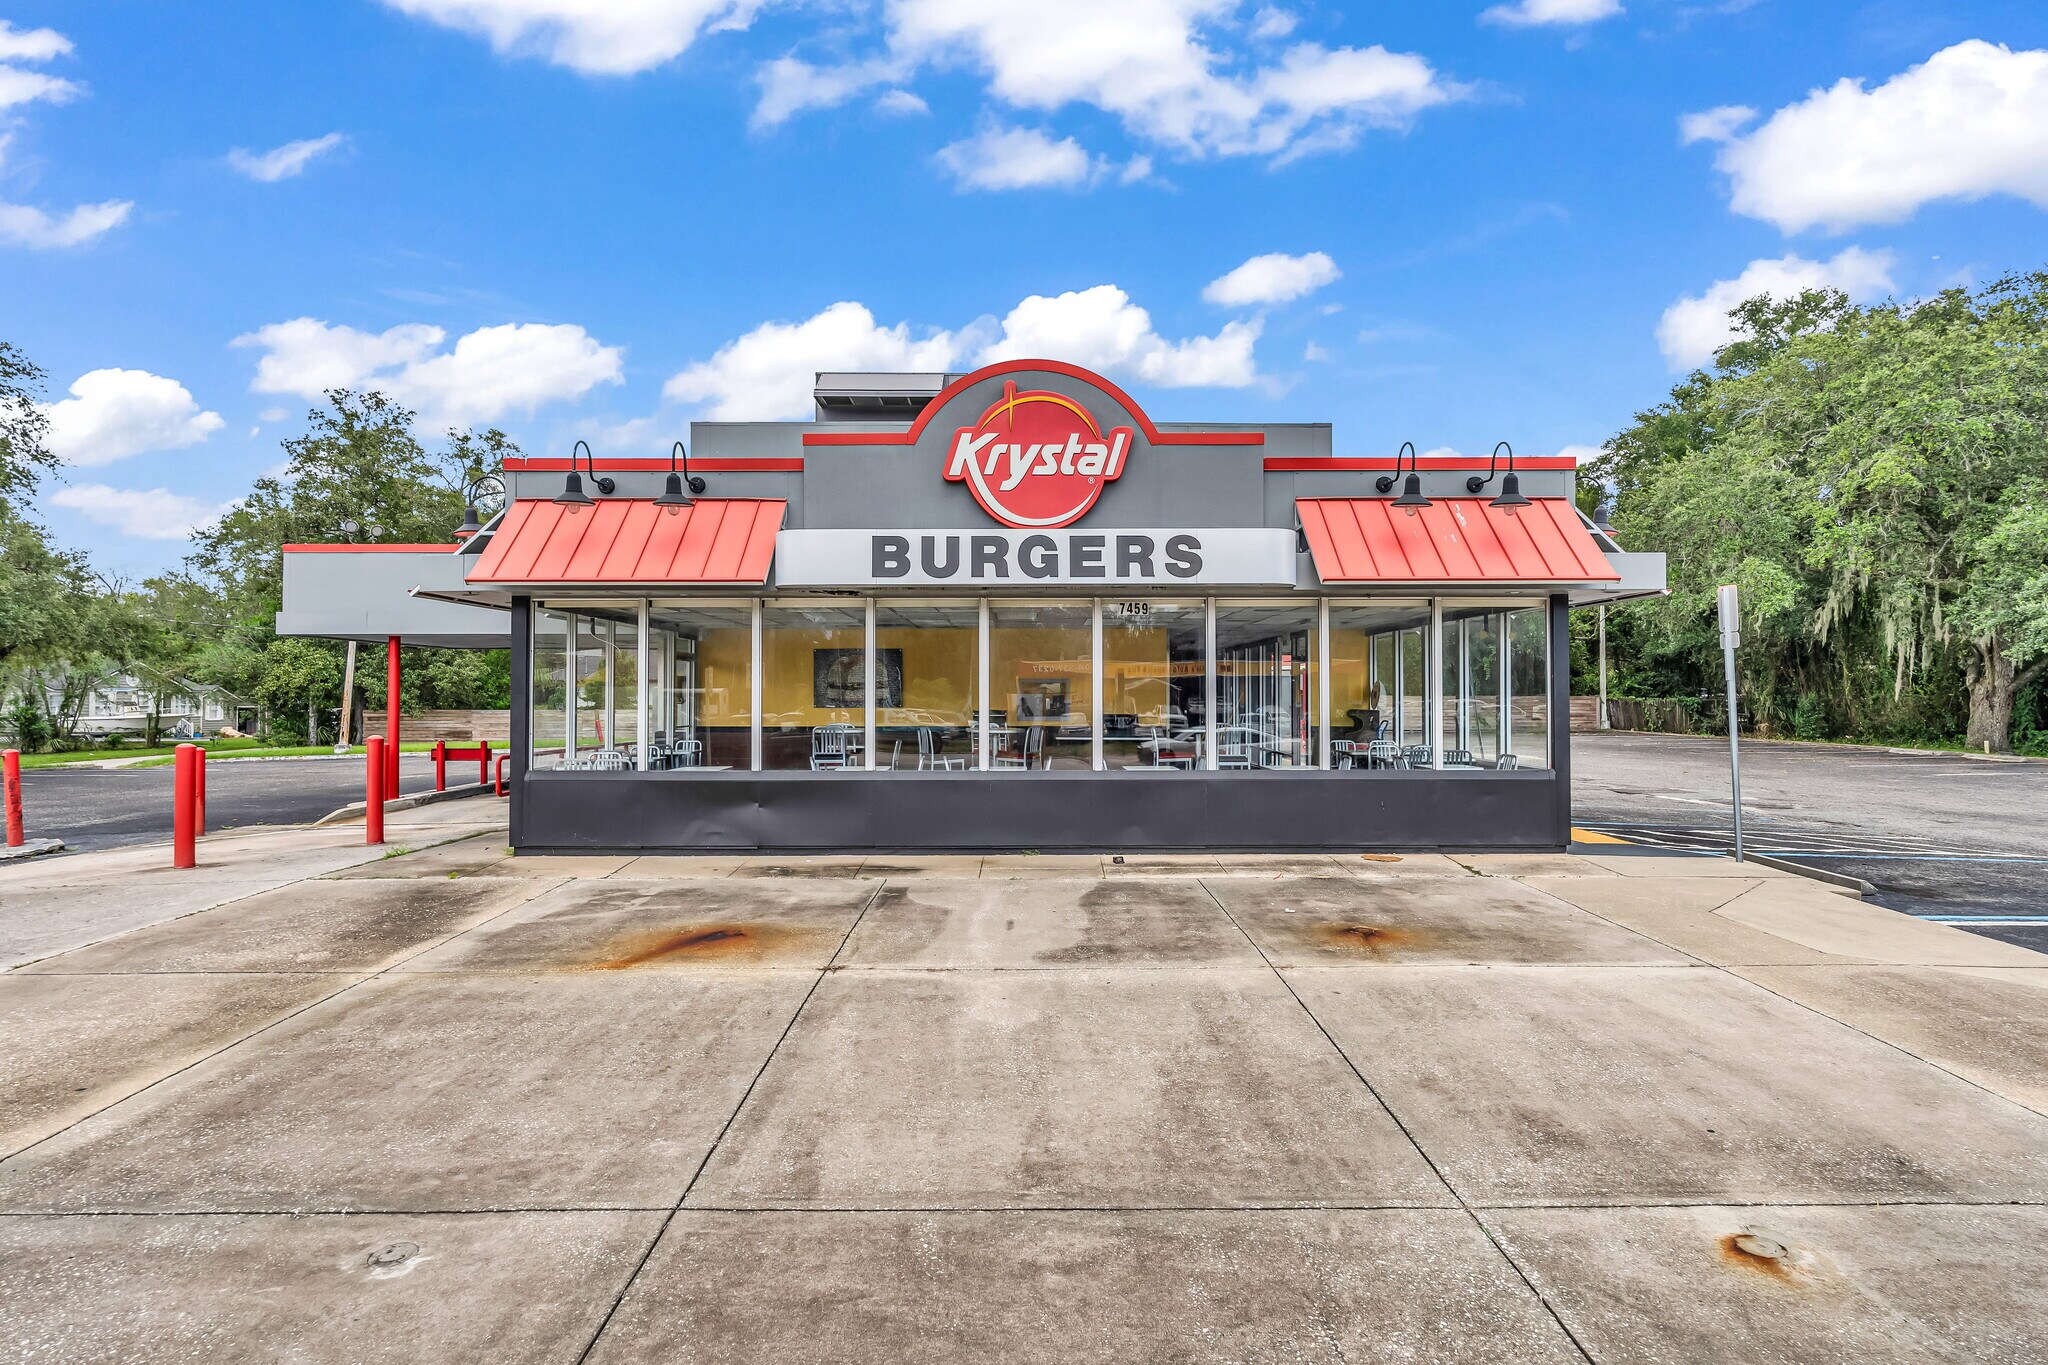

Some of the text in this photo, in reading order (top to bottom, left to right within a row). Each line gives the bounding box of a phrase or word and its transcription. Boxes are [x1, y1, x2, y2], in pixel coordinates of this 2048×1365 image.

[949, 432, 1126, 491] Krystal
[871, 534, 1203, 579] BURGERS
[1119, 602, 1148, 615] 7459
